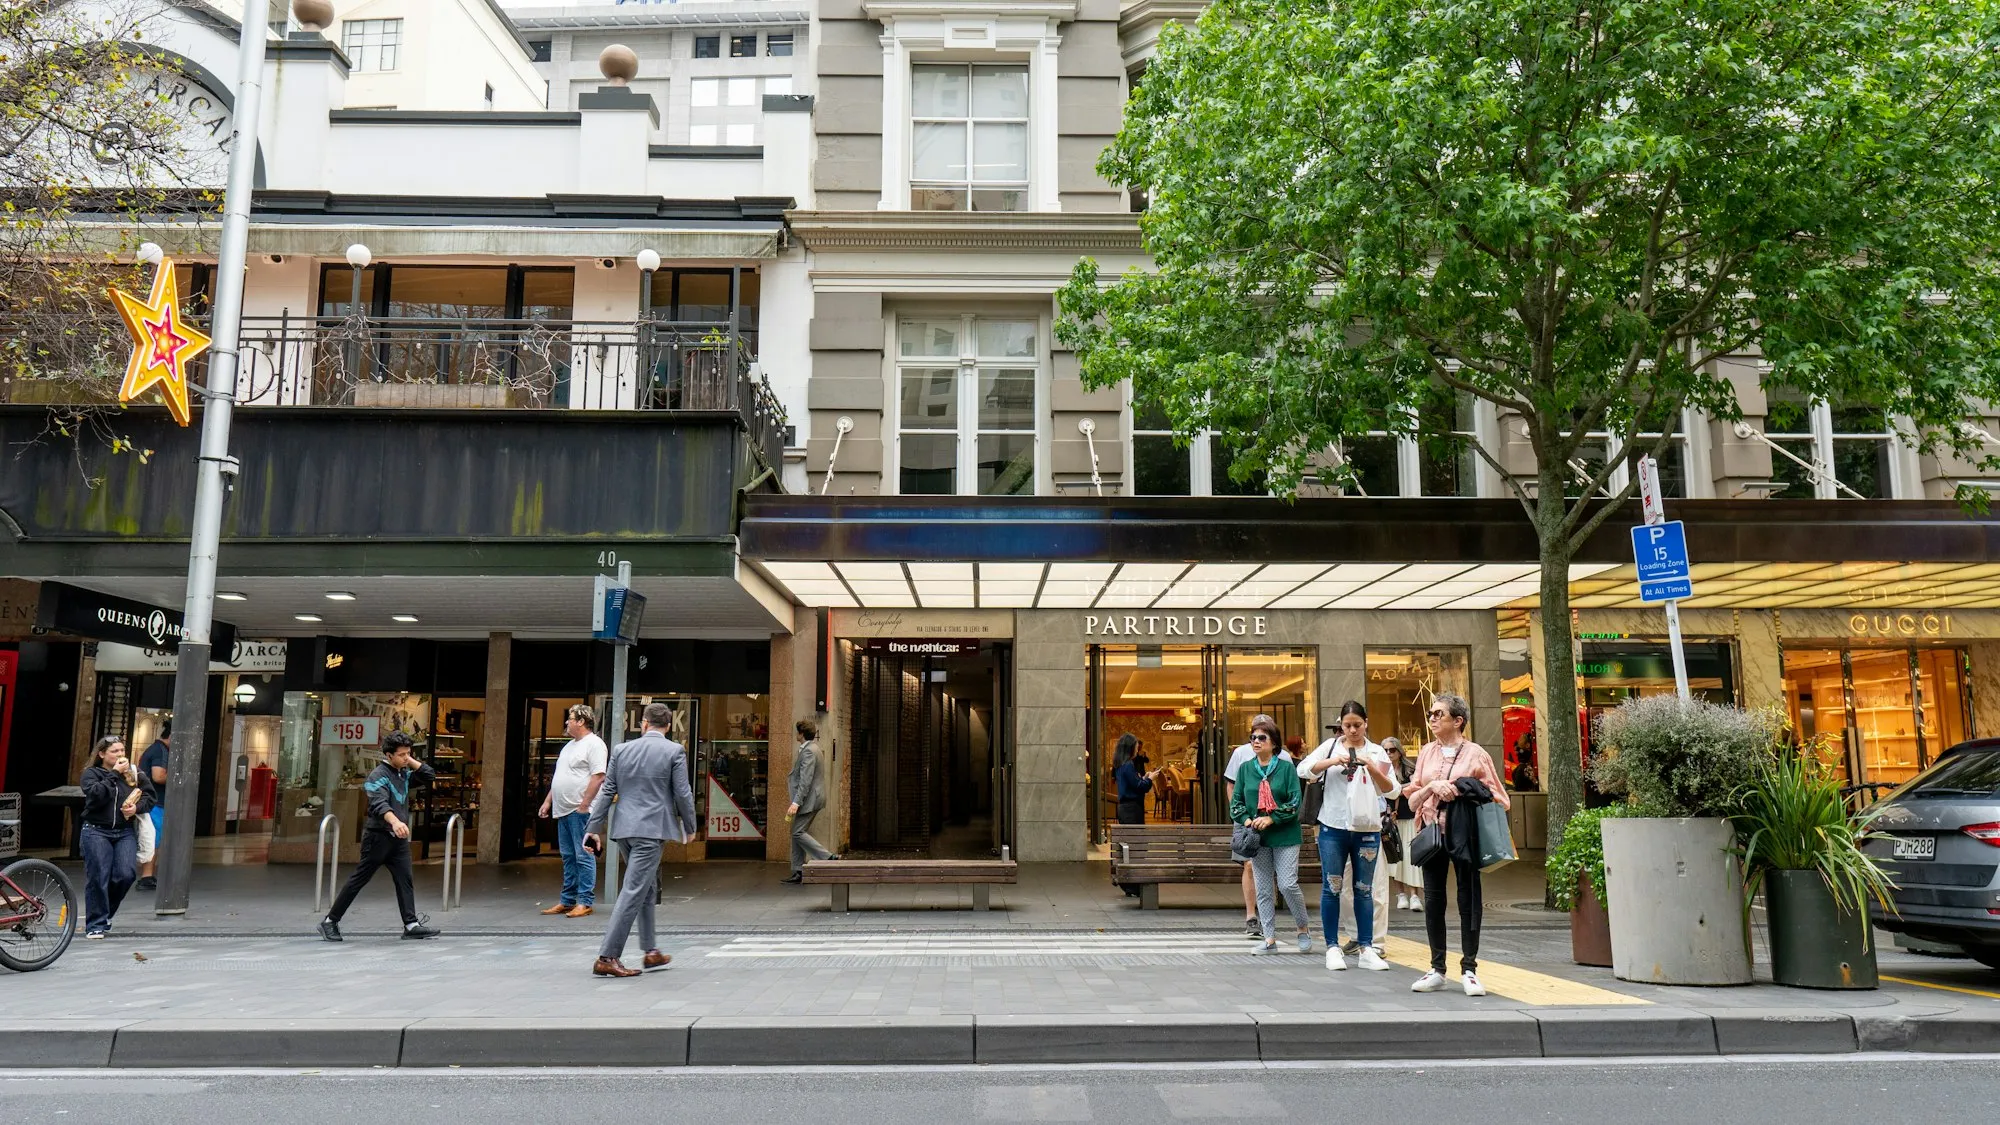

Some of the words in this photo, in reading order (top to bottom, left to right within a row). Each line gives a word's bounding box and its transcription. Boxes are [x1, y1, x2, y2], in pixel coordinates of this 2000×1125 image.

[1649, 527, 1666, 545] P
[597, 550, 616, 567] 40
[1653, 546, 1668, 561] 15
[1640, 562, 1666, 571] Loading
[1667, 560, 1685, 568] Zone
[1654, 587, 1665, 595] All
[1666, 585, 1688, 593] Times
[97, 607, 147, 630] QUEENS
[1084, 615, 1267, 636] PARTRIDGE
[1850, 614, 1953, 635] GUCCI
[888, 641, 908, 653] the
[333, 723, 364, 740] $159
[1161, 721, 1187, 731] Cartier
[711, 816, 741, 833] $159
[1894, 839, 1934, 854] PJH280
